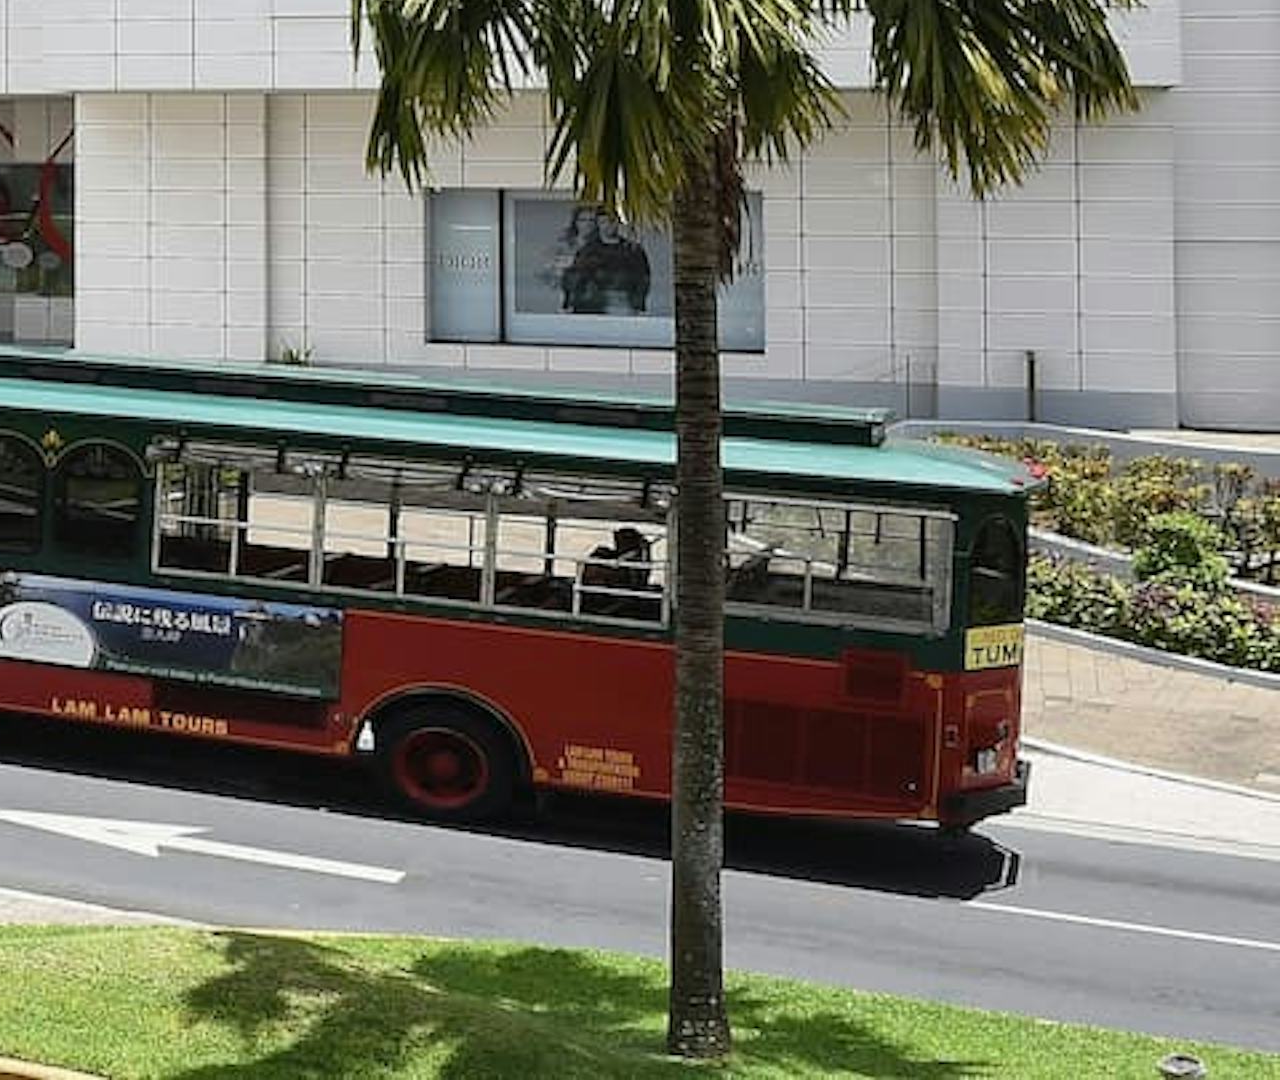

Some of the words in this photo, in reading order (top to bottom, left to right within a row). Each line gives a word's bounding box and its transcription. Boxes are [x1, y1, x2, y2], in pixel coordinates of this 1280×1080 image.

[973, 643, 1024, 664] TUM
[51, 696, 97, 717] LAM
[105, 703, 150, 726] LAM
[159, 710, 228, 734] TOURS
